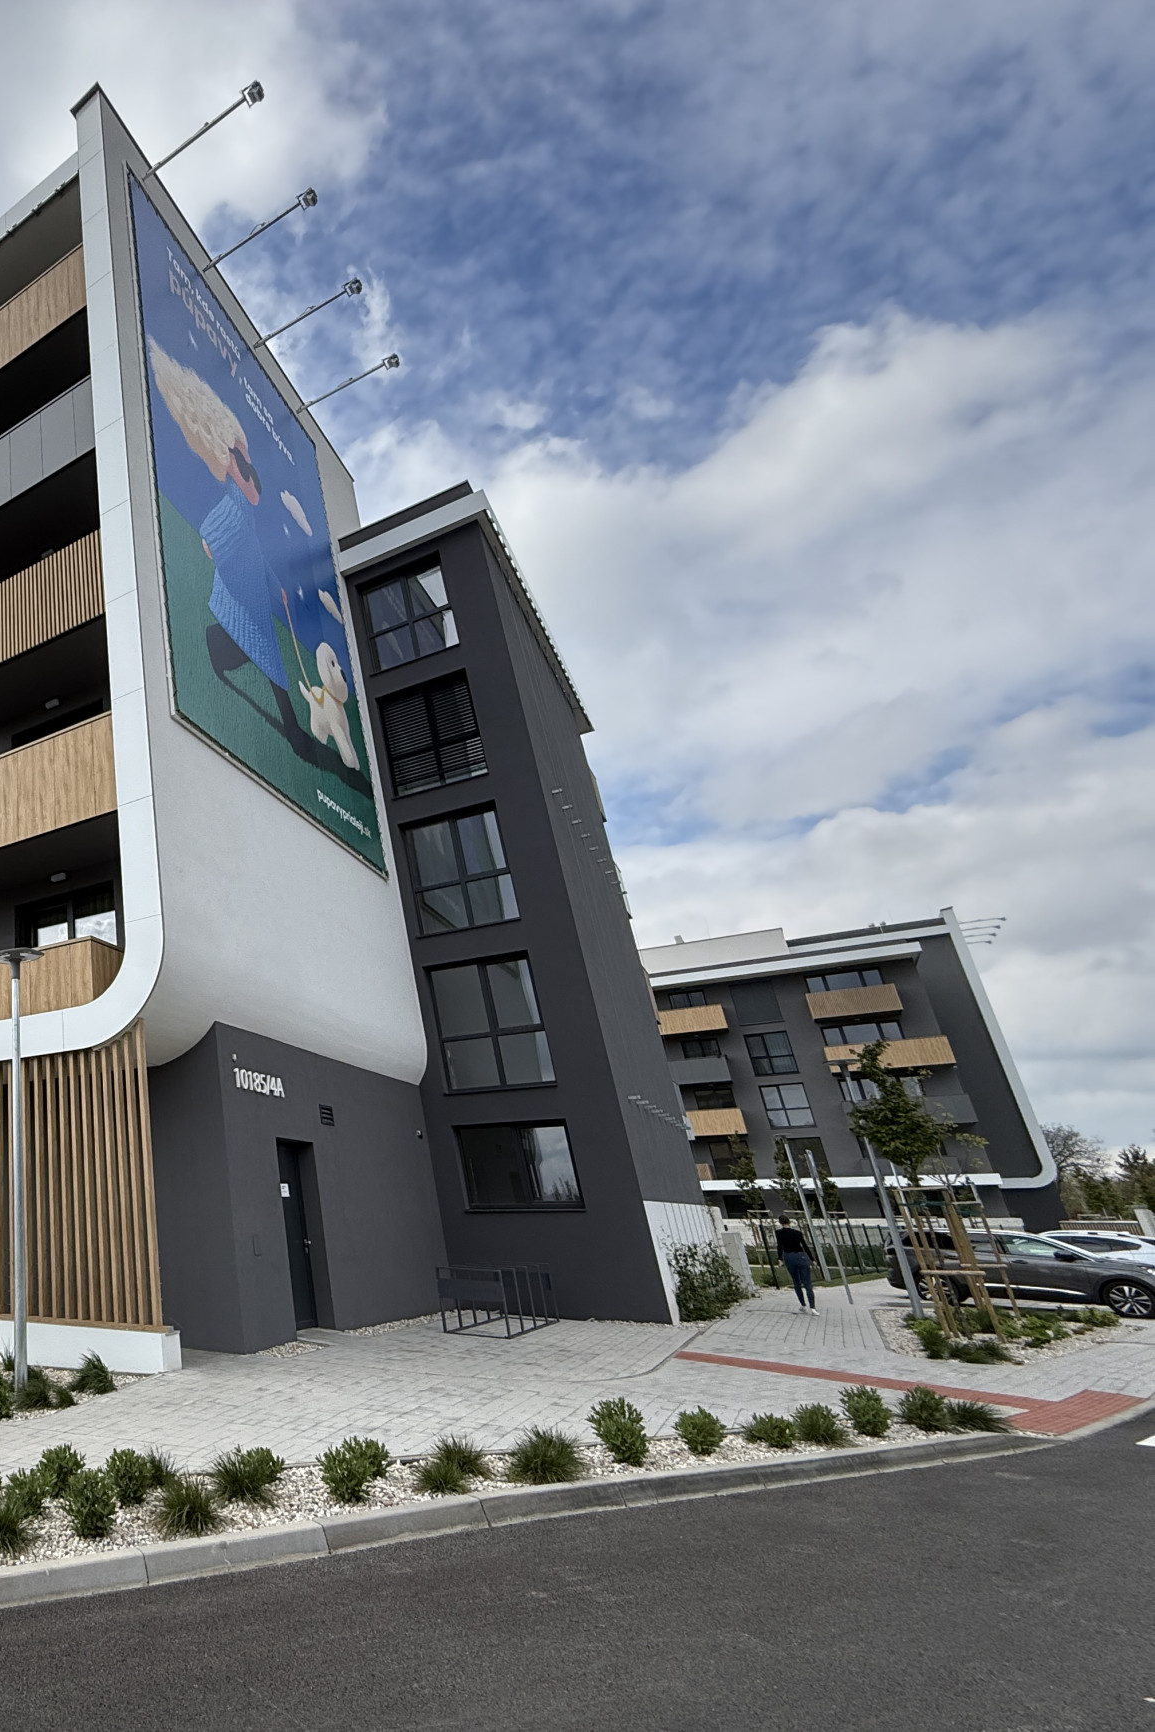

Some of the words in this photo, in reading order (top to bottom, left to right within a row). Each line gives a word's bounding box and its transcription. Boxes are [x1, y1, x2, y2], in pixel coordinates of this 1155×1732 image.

[166, 246, 194, 295] Tam,
[195, 287, 215, 322] kde
[243, 376, 262, 409] tam
[263, 406, 274, 426] sa
[245, 393, 271, 433] dobre
[233, 1067, 285, 1098] 10185/4A
